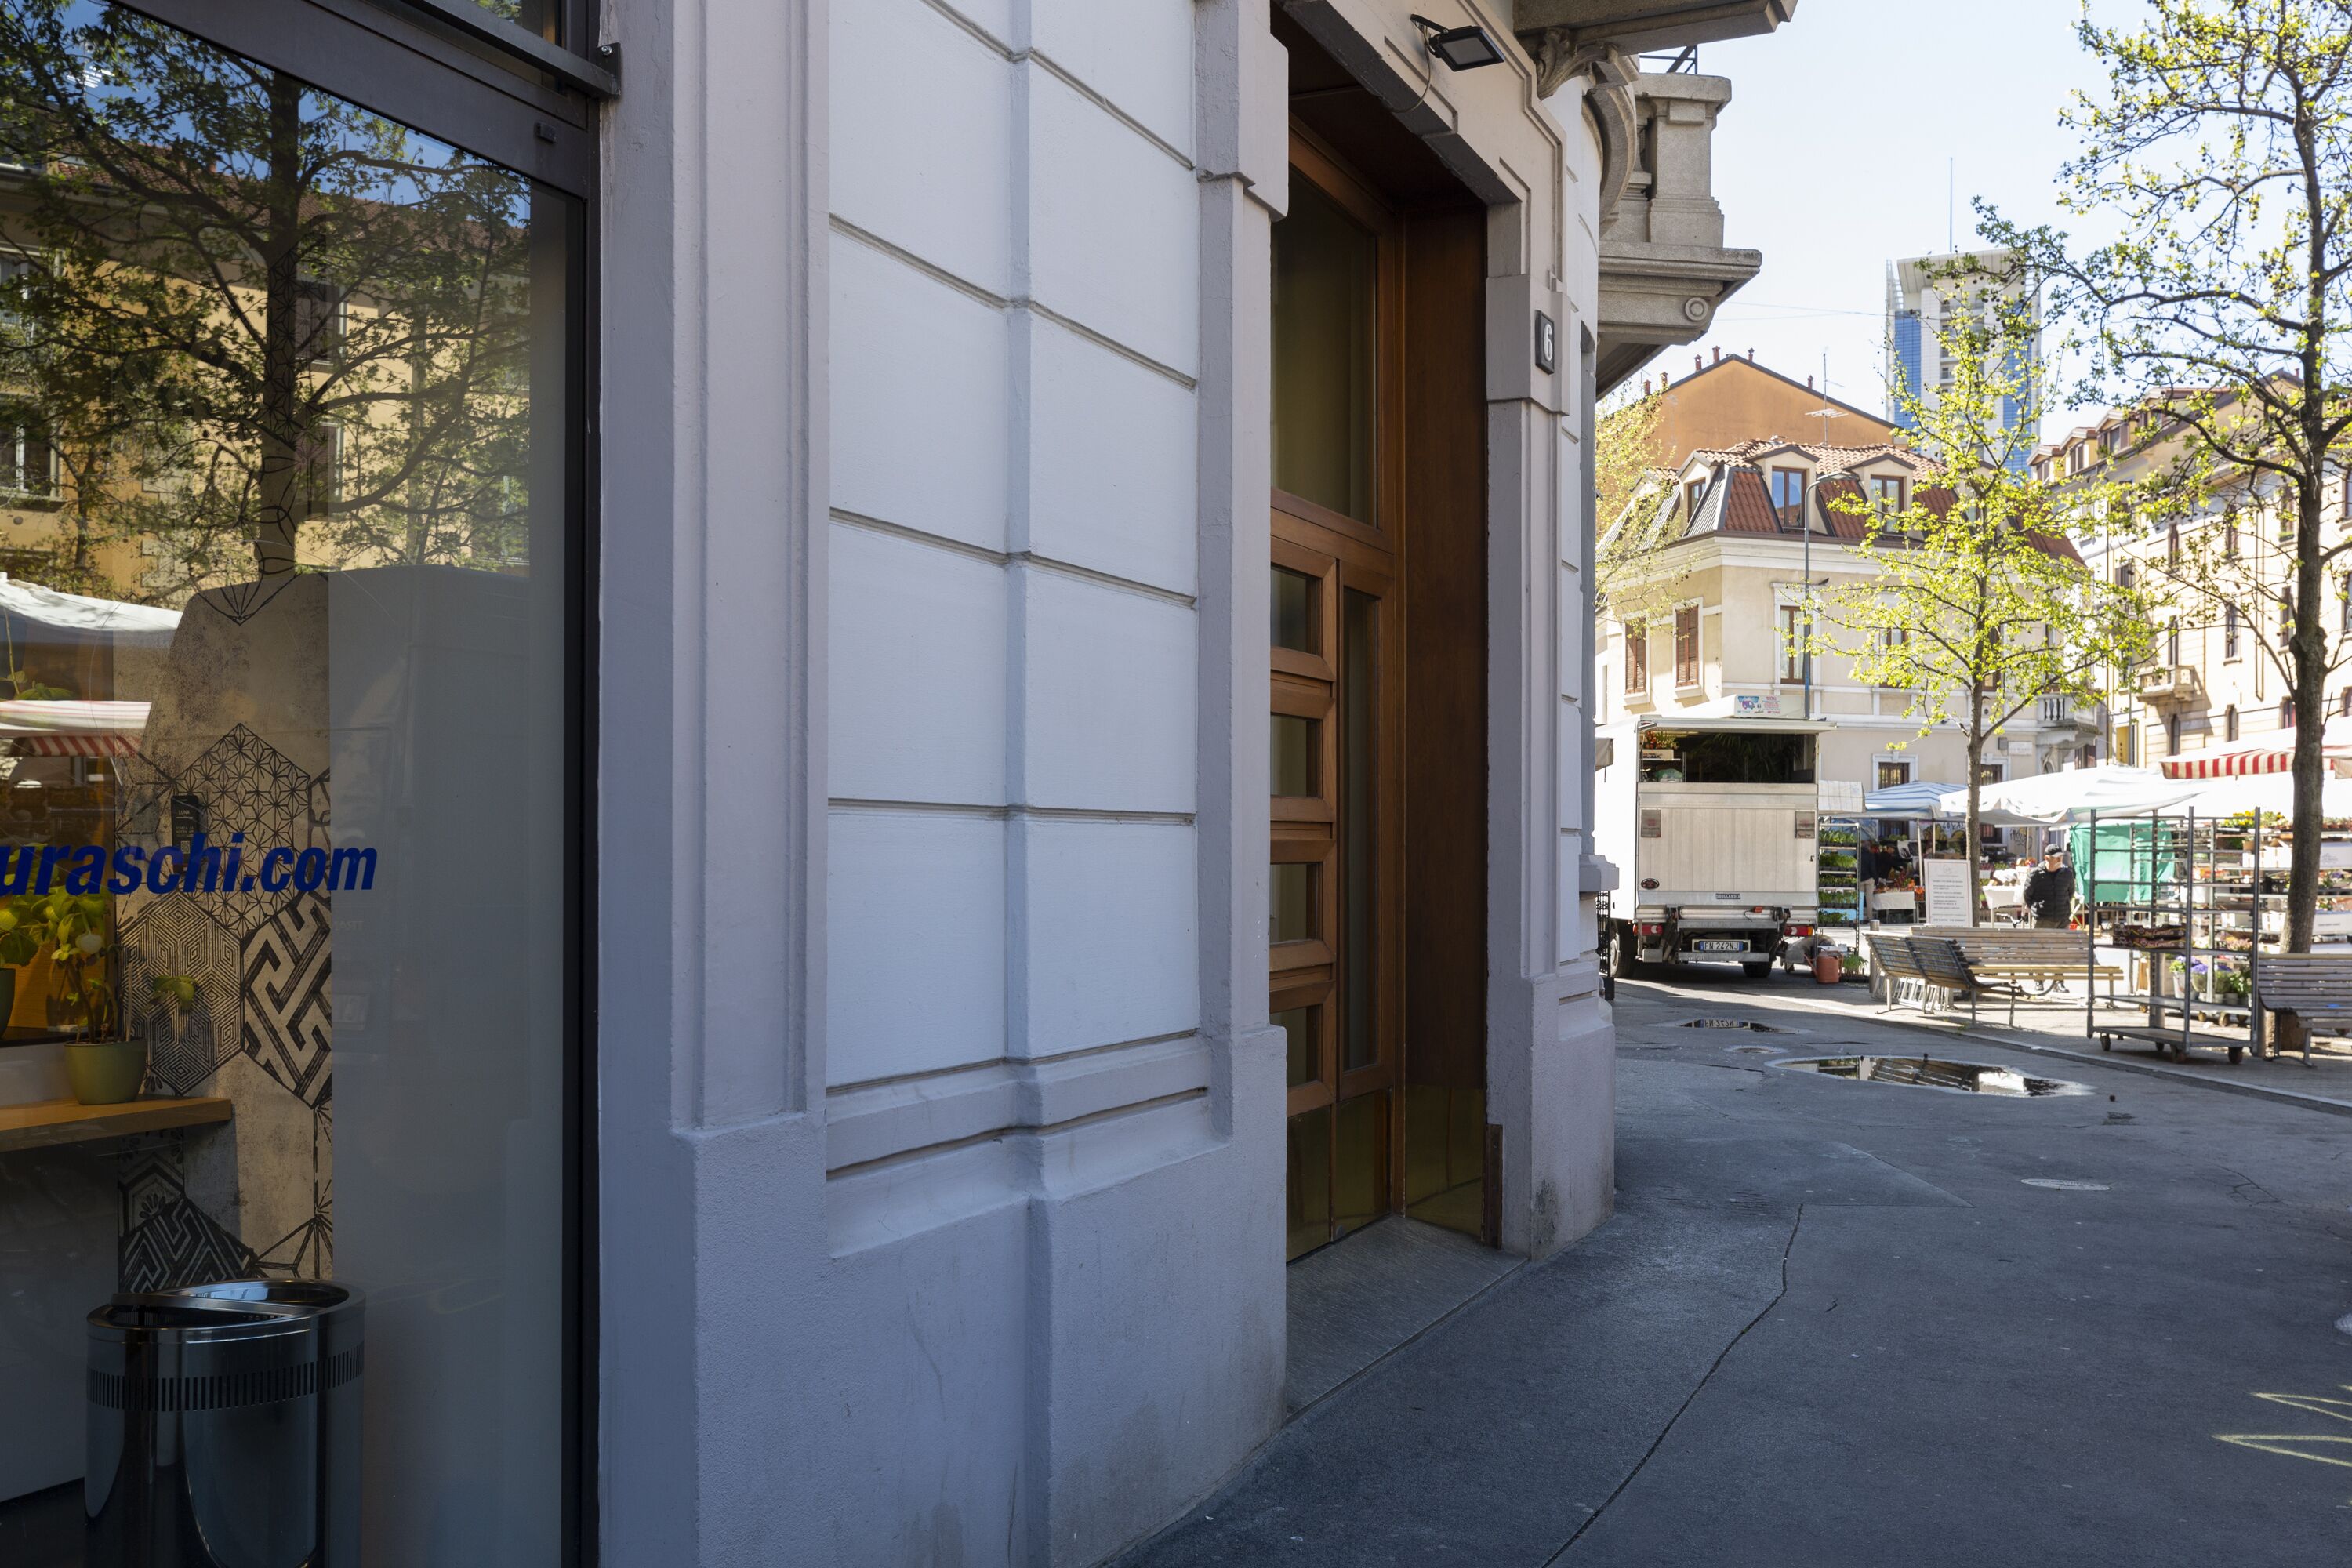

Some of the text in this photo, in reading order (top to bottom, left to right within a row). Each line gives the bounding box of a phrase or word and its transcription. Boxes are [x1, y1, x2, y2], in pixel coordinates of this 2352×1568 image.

[1544, 323, 1553, 361] 6
[0, 833, 378, 895] uraschi.com
[1704, 942, 1739, 950] FN 242NJ
